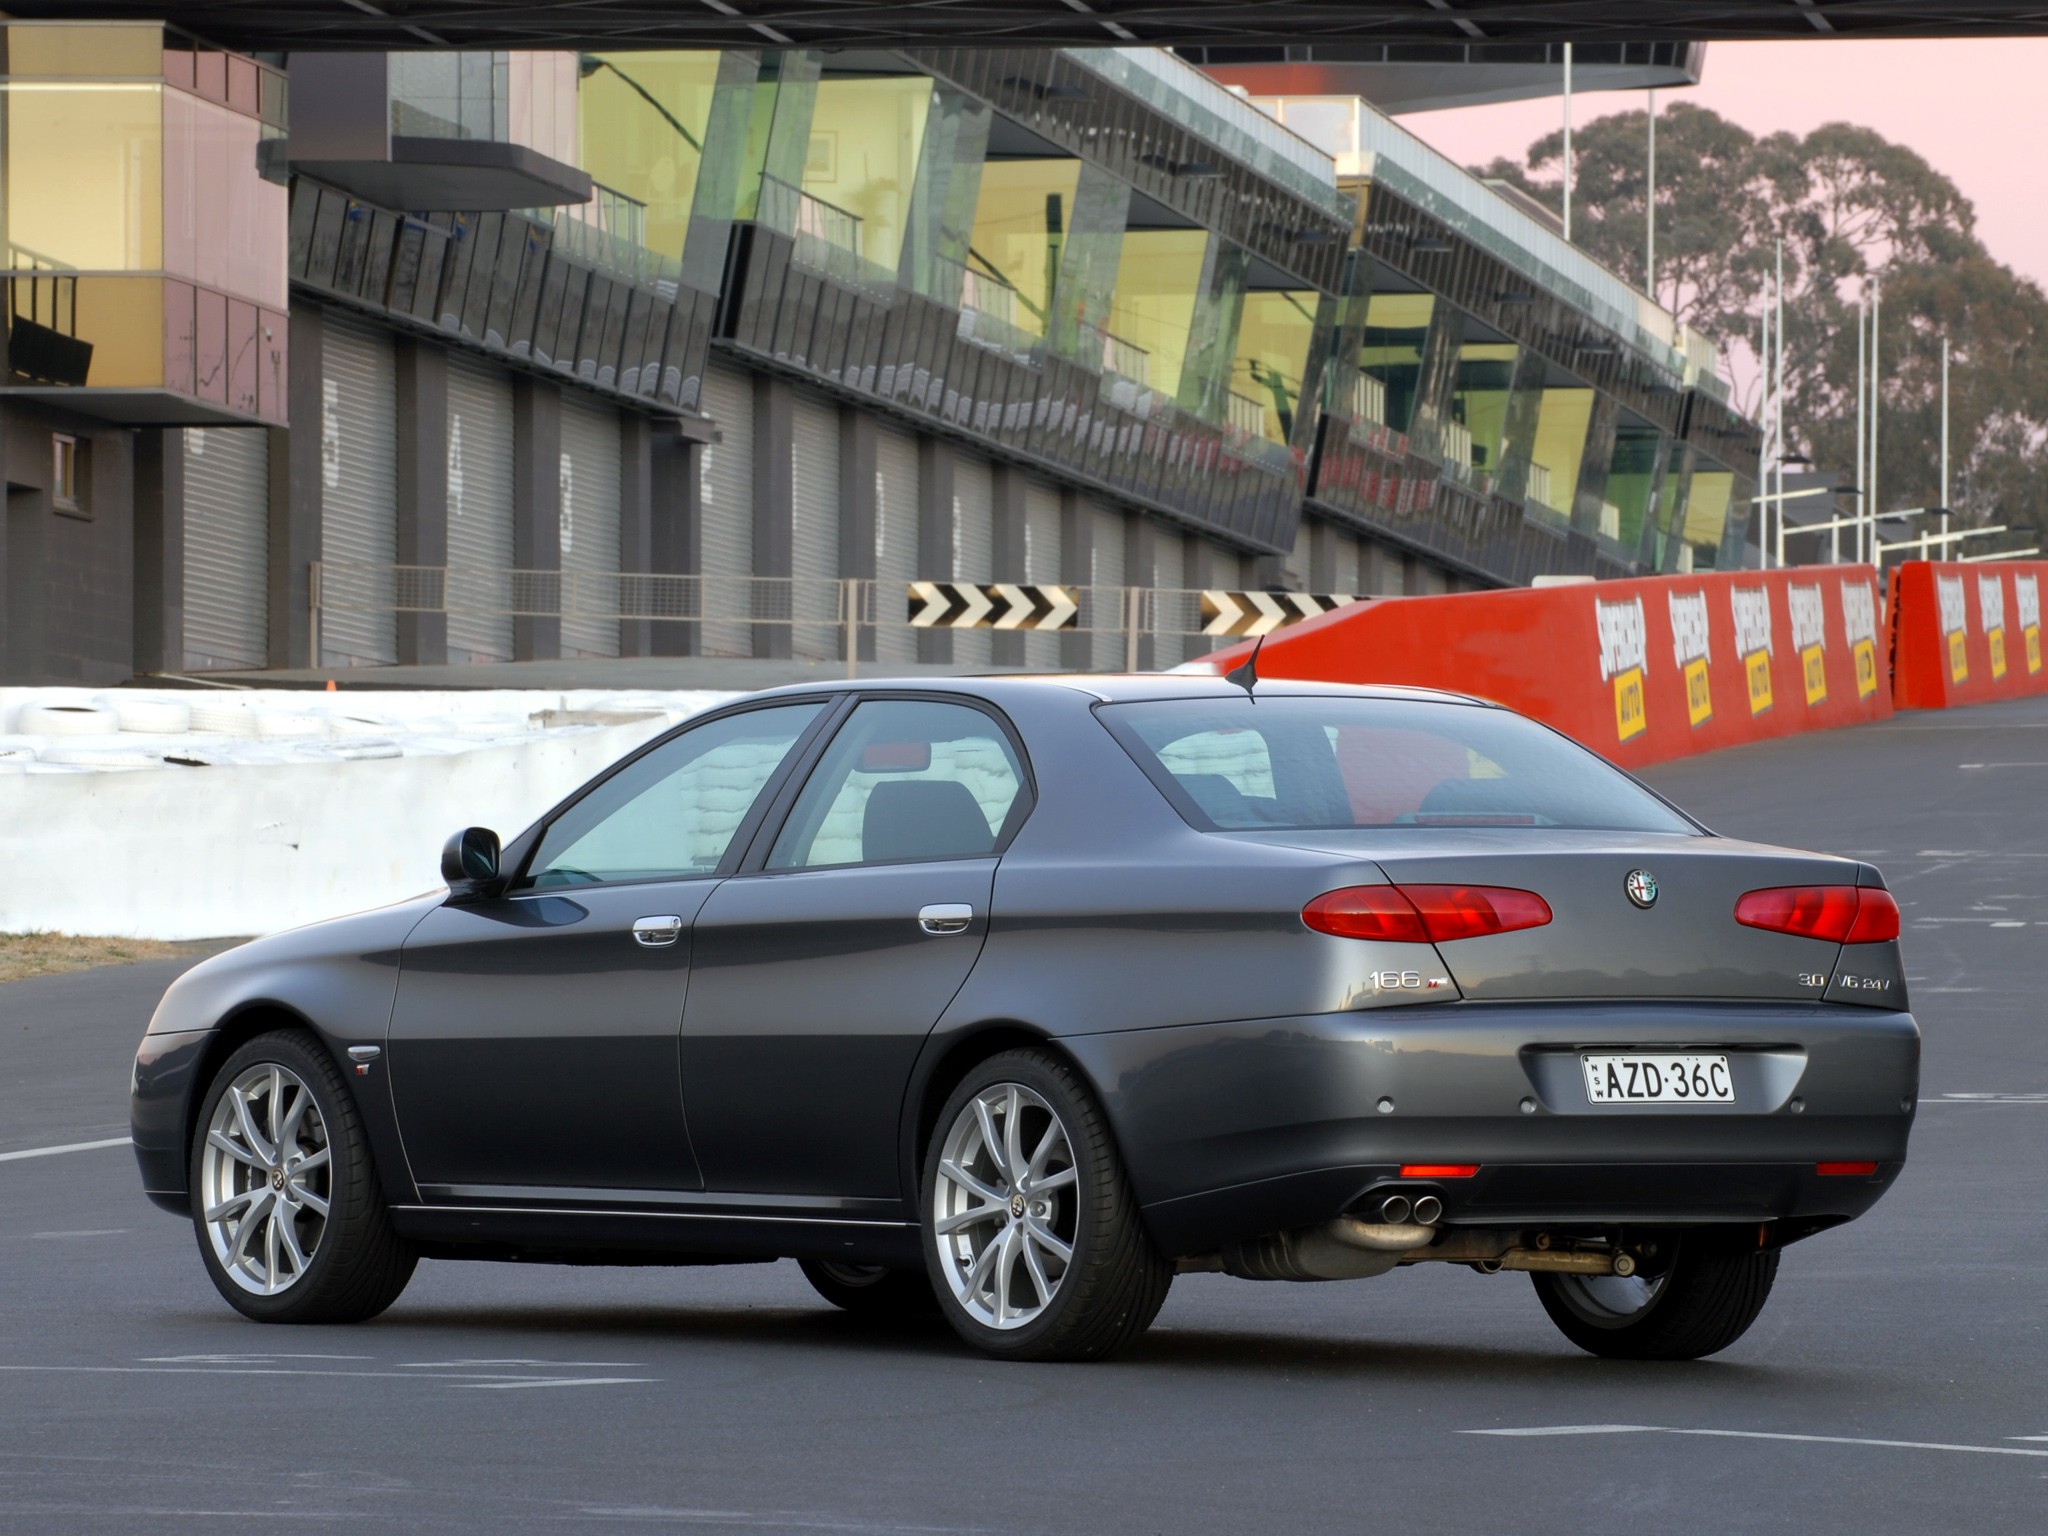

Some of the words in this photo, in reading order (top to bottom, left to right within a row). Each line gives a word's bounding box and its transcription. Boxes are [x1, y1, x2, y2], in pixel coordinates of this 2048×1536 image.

[1619, 681, 1641, 725] AUTO
[1369, 970, 1421, 989] 166
[1836, 974, 1858, 988] V6
[1862, 978, 1890, 991] 24V
